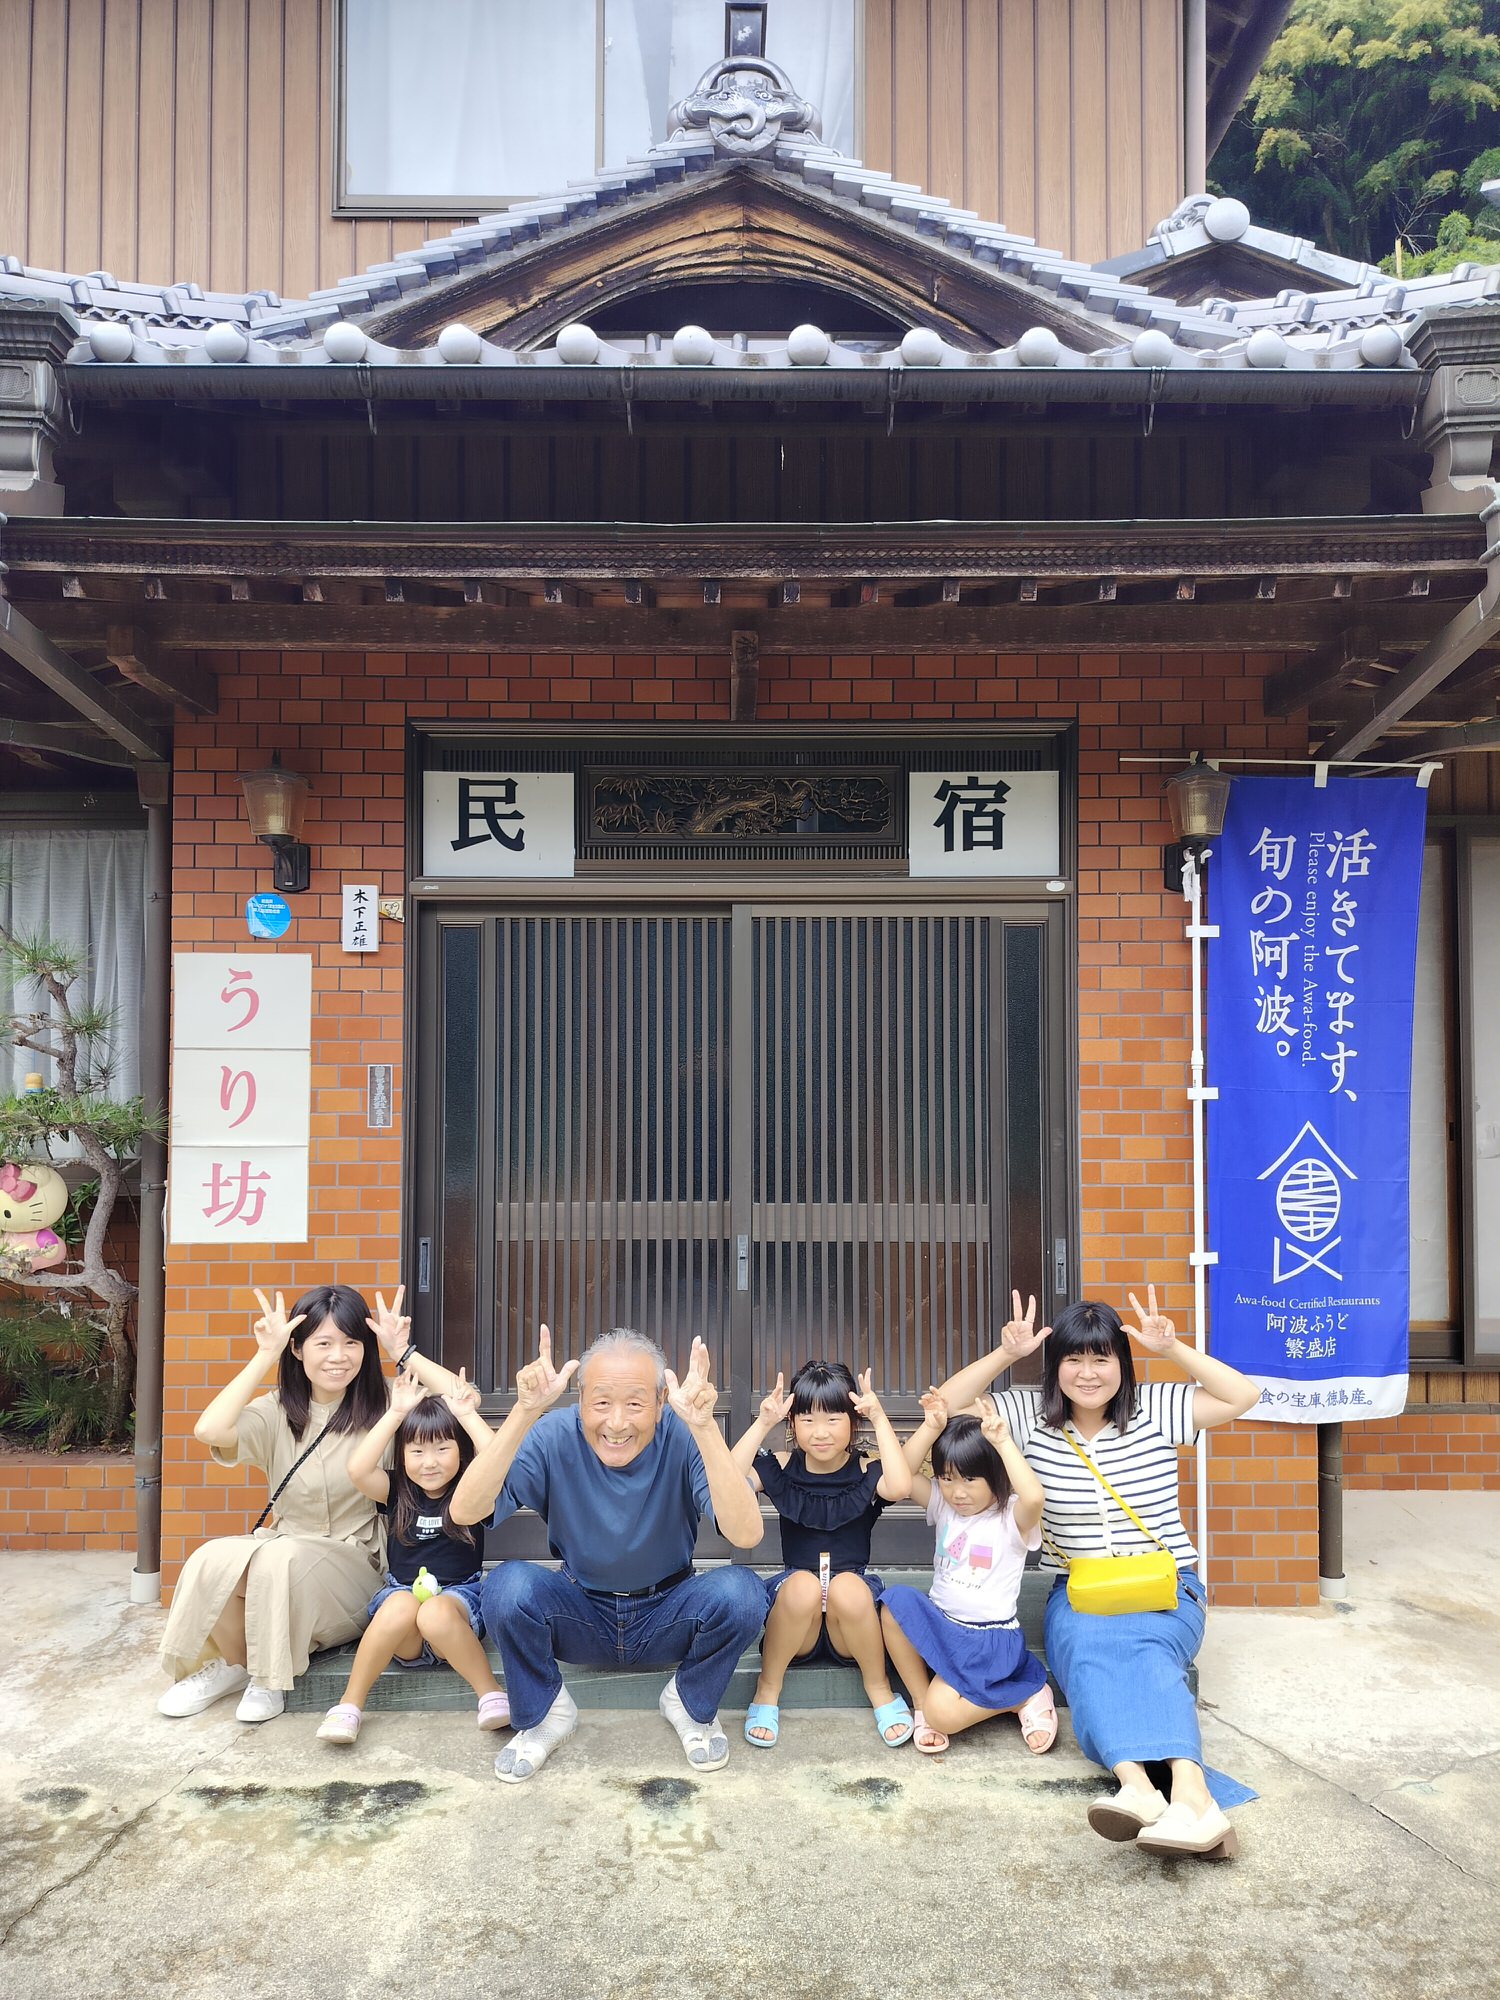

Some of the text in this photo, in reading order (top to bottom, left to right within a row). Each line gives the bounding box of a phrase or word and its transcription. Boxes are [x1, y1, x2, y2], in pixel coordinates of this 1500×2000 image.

[450, 775, 1011, 852] 民 宿
[352, 888, 369, 947] 木下正雄
[1249, 826, 1300, 1057] 旬の阿波。
[1300, 831, 1325, 1067] Please enjoy the Awa-food.
[1320, 828, 1377, 1102] 活きてます、
[201, 967, 271, 1228] うり坊
[1234, 1293, 1381, 1310] Awa-food Certified Restaurants
[1266, 1312, 1349, 1335] 阿波ふうど
[1284, 1336, 1337, 1359] 繁盛店
